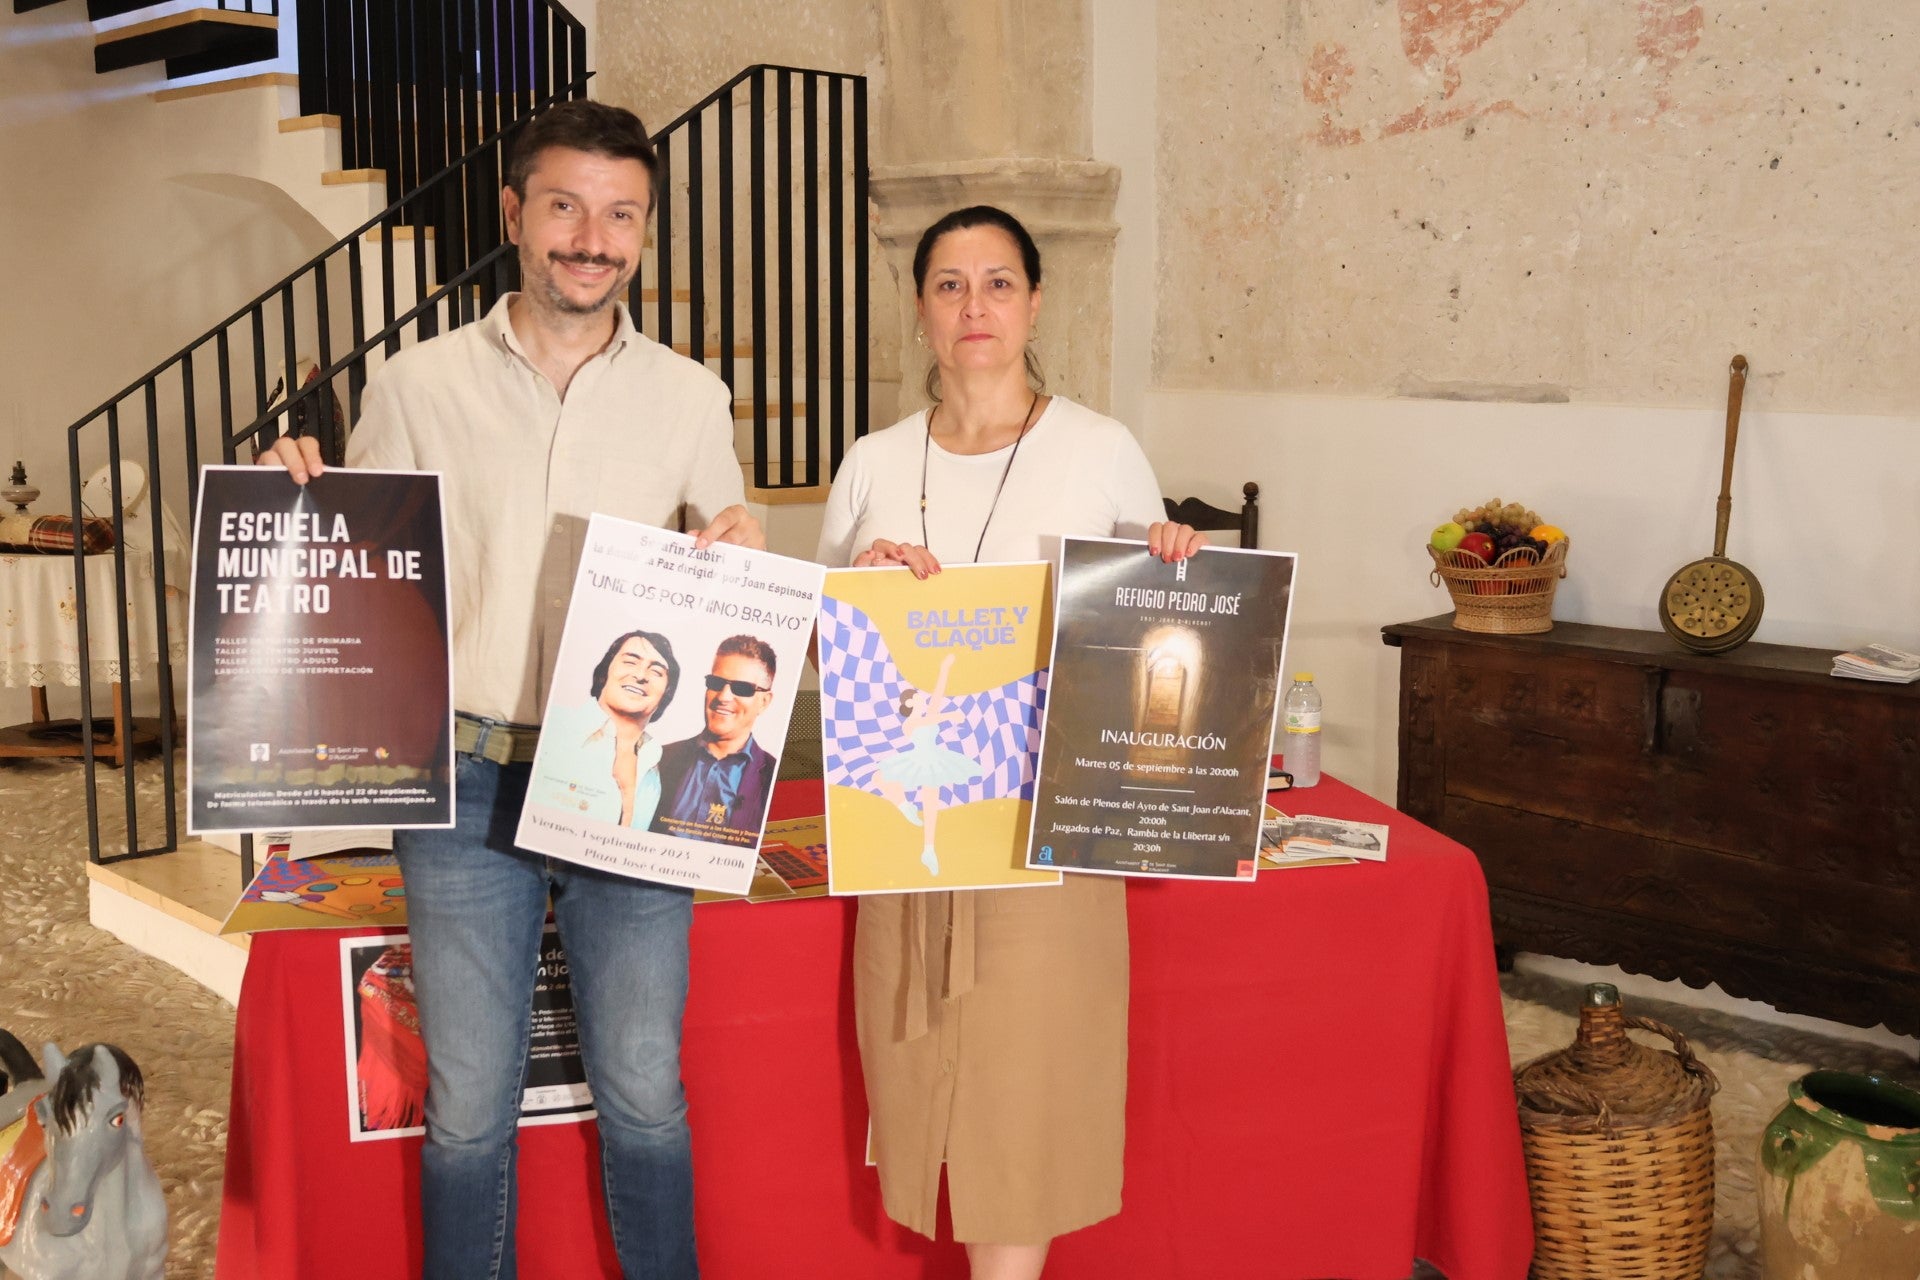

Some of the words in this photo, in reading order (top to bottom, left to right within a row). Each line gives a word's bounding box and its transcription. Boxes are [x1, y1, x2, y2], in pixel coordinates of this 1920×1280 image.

[219, 511, 350, 543] ESCUELA
[217, 548, 376, 579] MUNICIPAL
[387, 550, 422, 580] DE
[656, 557, 675, 571] Paz
[677, 562, 717, 580] dirigid
[741, 576, 766, 591] Joan
[768, 582, 814, 601] Espinosa
[216, 583, 330, 614] TEATRO
[1115, 586, 1166, 610] REFUGIO
[1168, 590, 1207, 613] PEDRO
[1209, 592, 1242, 615] JOSÉ
[740, 605, 807, 631] BRAVO"
[907, 607, 1006, 630] BALLET
[1012, 605, 1029, 625] Y
[317, 637, 362, 645] PRIMARIA
[914, 621, 1016, 651] CLAQUÉ
[302, 657, 339, 665] ADULTO
[1100, 729, 1227, 751] INAUGURACIÓN
[1074, 757, 1107, 769] Martes
[1108, 761, 1121, 771] 05
[1122, 761, 1135, 771] de
[1136, 763, 1186, 774] septiembre
[1195, 765, 1208, 776] las
[1209, 767, 1240, 778] 20:00h
[320, 788, 345, 797] hasta
[345, 787, 354, 796] el
[367, 787, 379, 796] de
[206, 800, 219, 809] De
[1054, 794, 1078, 806] Salón
[1079, 797, 1091, 807] de
[1092, 798, 1121, 809] Plenos
[1121, 800, 1136, 810] del
[1136, 801, 1158, 813] Ayto
[1158, 802, 1170, 812] de
[1171, 803, 1190, 813] Sant
[1191, 804, 1211, 816] Joan
[1212, 805, 1252, 817] d'Alacant,
[1050, 822, 1090, 834] Juzgados
[1091, 825, 1103, 835] de
[1104, 825, 1122, 836] Paz,
[1126, 827, 1159, 838] Rambla
[1160, 830, 1172, 839] de
[1172, 830, 1181, 840] la
[1182, 831, 1217, 842] Llibertat
[1217, 833, 1231, 842] s/n
[1138, 816, 1167, 826] 20:00h
[589, 832, 657, 854] septiembre
[659, 847, 691, 860] 2023
[708, 855, 745, 870] 21:00h
[1132, 843, 1162, 853] 20:30h
[584, 847, 618, 864] Plaza
[650, 863, 701, 880] Carreras
